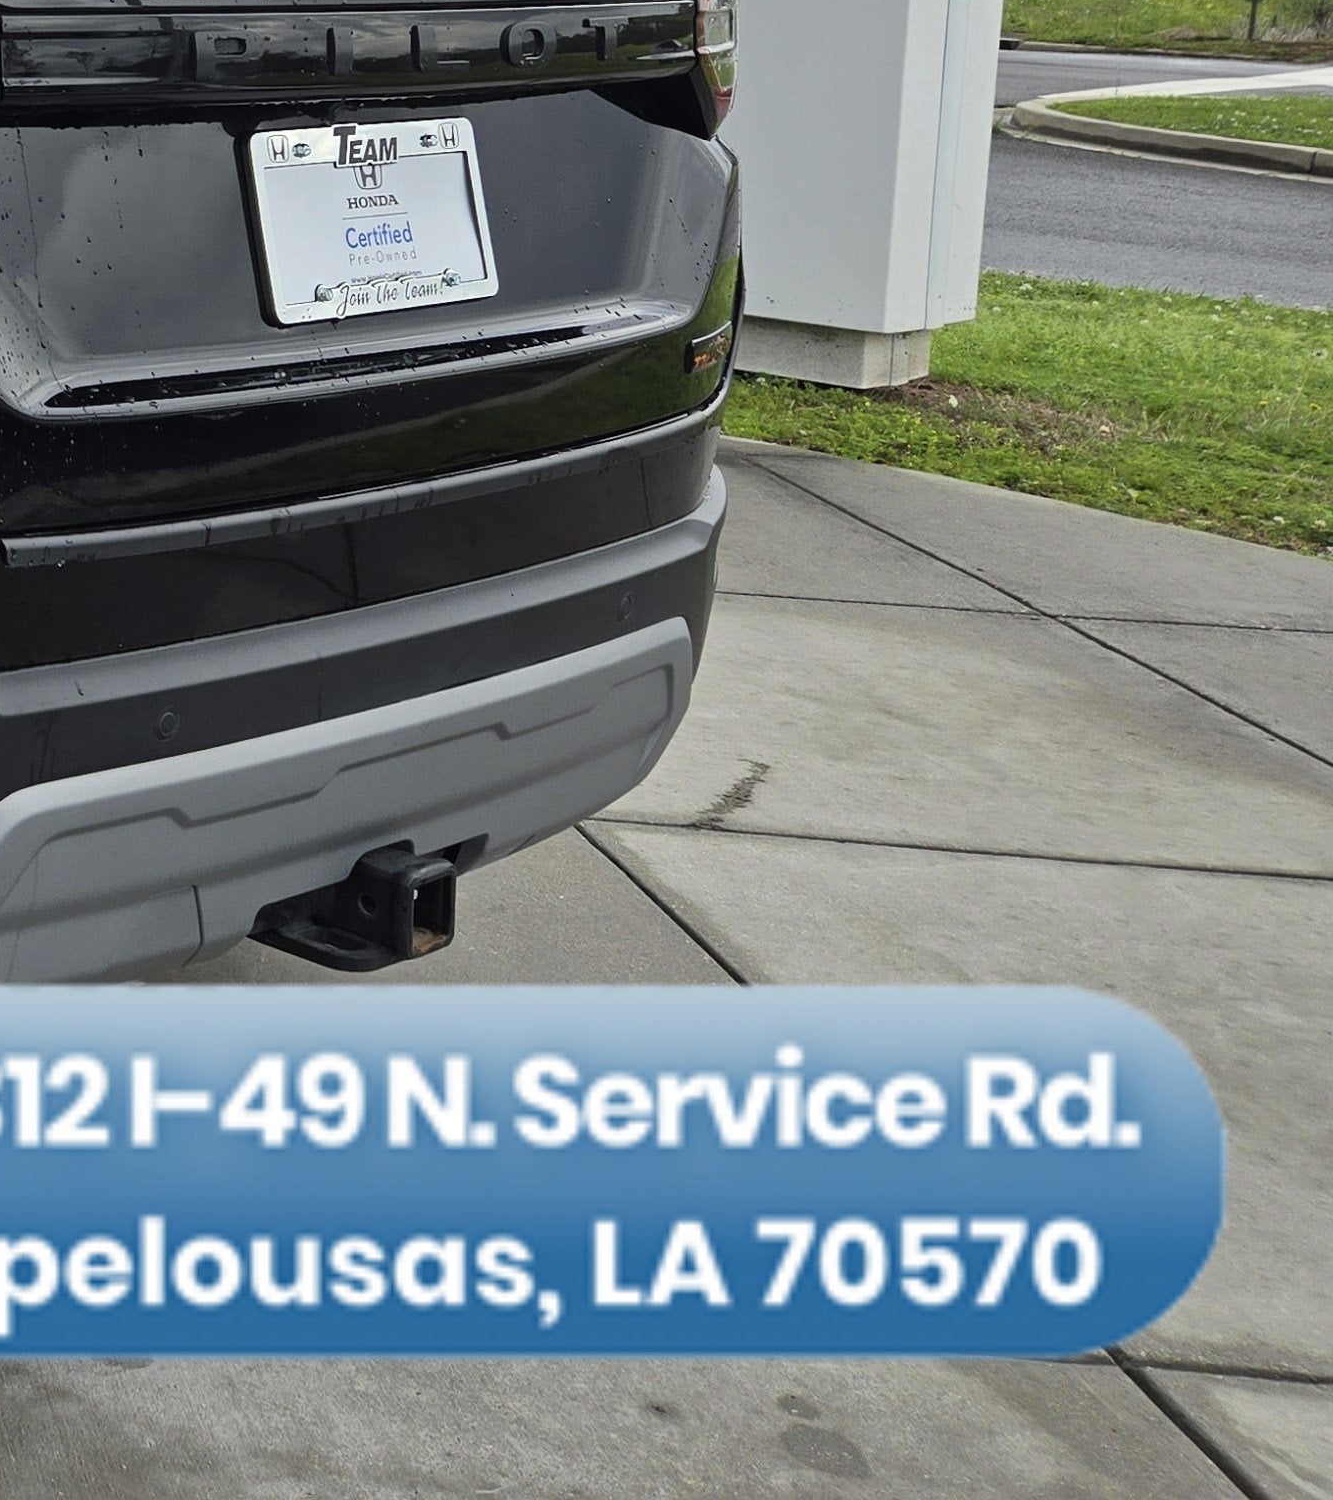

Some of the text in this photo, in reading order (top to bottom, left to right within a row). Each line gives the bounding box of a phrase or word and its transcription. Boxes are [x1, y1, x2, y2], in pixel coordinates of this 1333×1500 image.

[190, 15, 629, 82] PILOT
[346, 194, 399, 210] HONDA
[345, 221, 414, 250] Certified
[348, 246, 417, 267] Pre-Owned
[336, 284, 372, 317] Join
[372, 279, 399, 304] The
[400, 276, 444, 301] Team!
